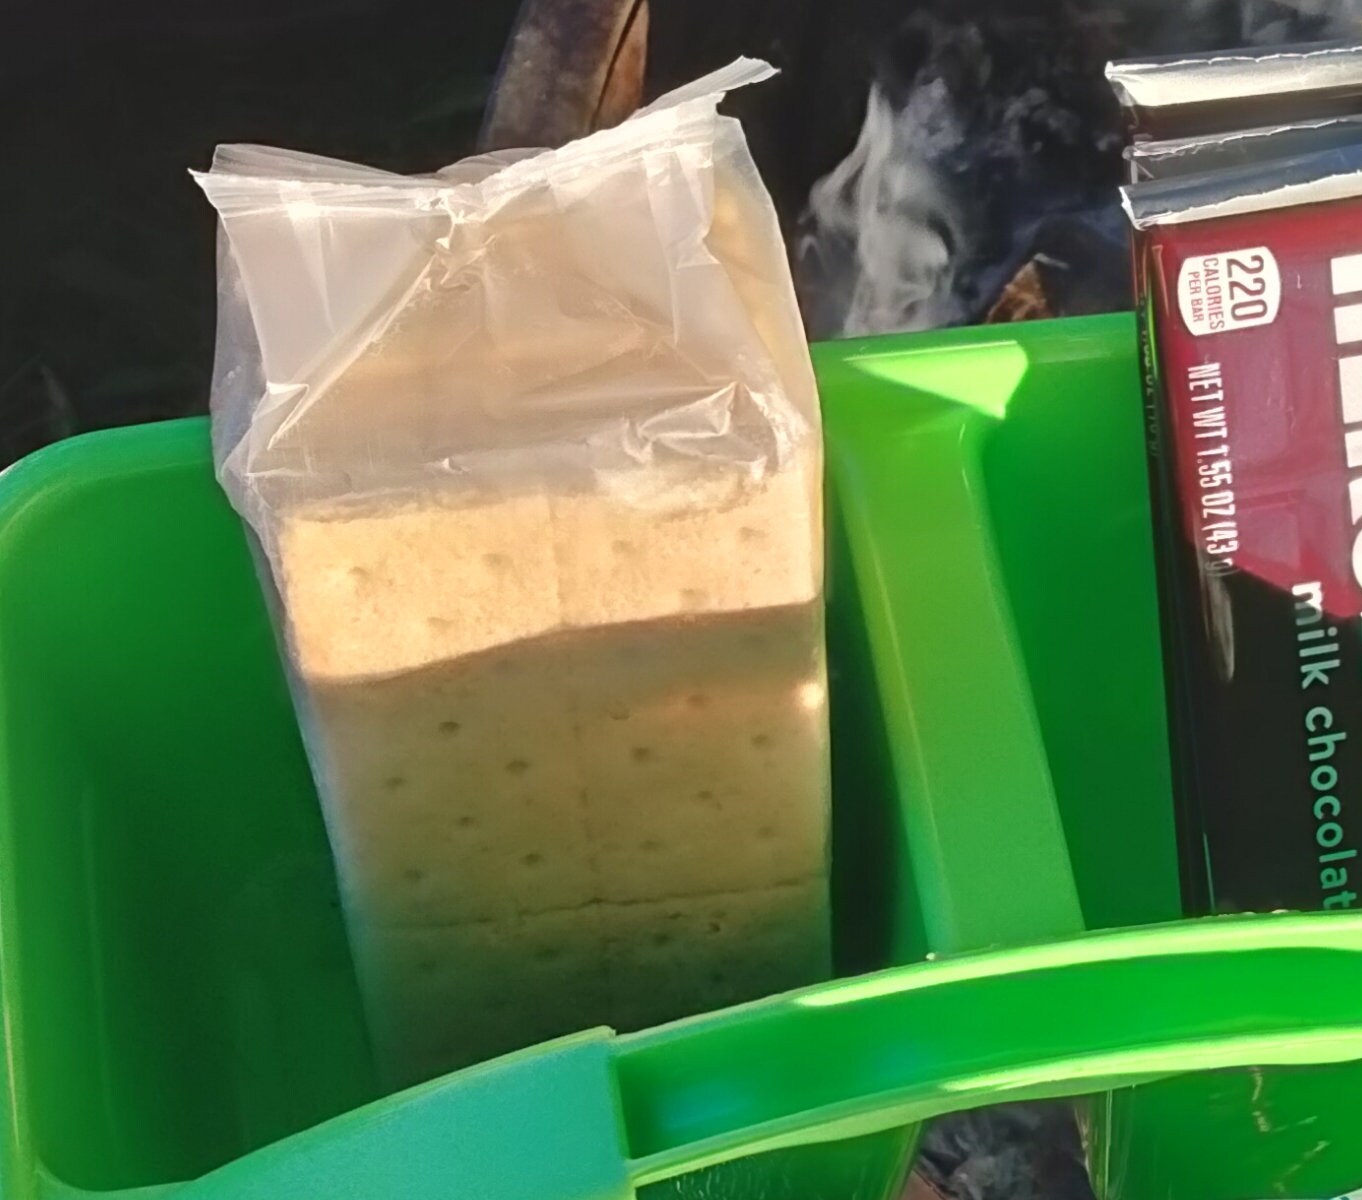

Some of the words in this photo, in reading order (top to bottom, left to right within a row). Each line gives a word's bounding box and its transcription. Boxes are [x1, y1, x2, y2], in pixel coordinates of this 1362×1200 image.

[1187, 270, 1203, 296] PER
[1202, 258, 1226, 331] CALORIES
[1226, 255, 1268, 321] 220
[1189, 298, 1205, 323] BAR
[1187, 362, 1224, 401] NET
[1192, 405, 1228, 440] WT
[1196, 444, 1232, 488] 1.55
[1201, 493, 1234, 518] OZ
[1292, 581, 1342, 689] milk
[1302, 706, 1359, 910] chocolat
